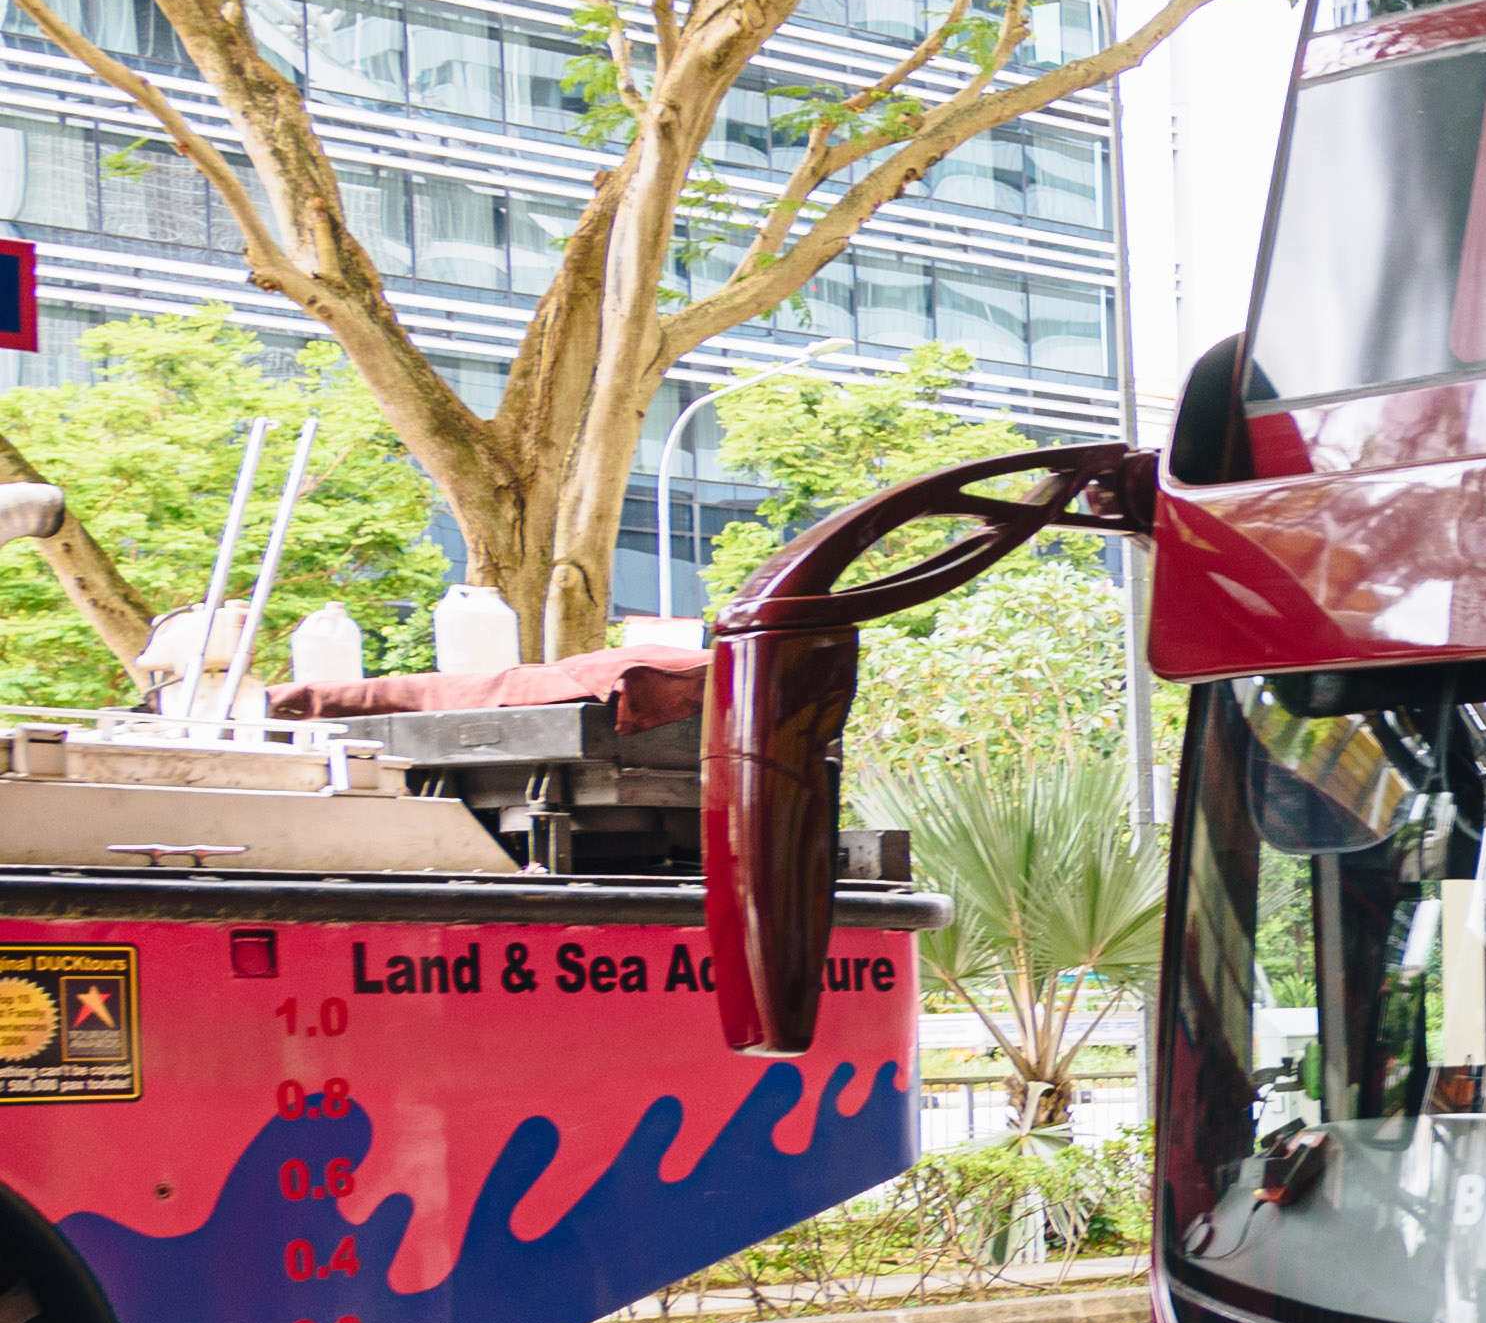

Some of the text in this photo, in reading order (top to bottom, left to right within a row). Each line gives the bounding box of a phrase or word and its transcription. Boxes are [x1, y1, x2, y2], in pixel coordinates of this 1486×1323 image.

[353, 941, 481, 994] Land
[501, 941, 538, 993] &
[555, 942, 648, 993] Sea
[275, 996, 349, 1038] 1.0
[276, 1078, 352, 1120] 0.8
[279, 1157, 356, 1201] 0.6
[284, 1235, 361, 1282] 0.4
